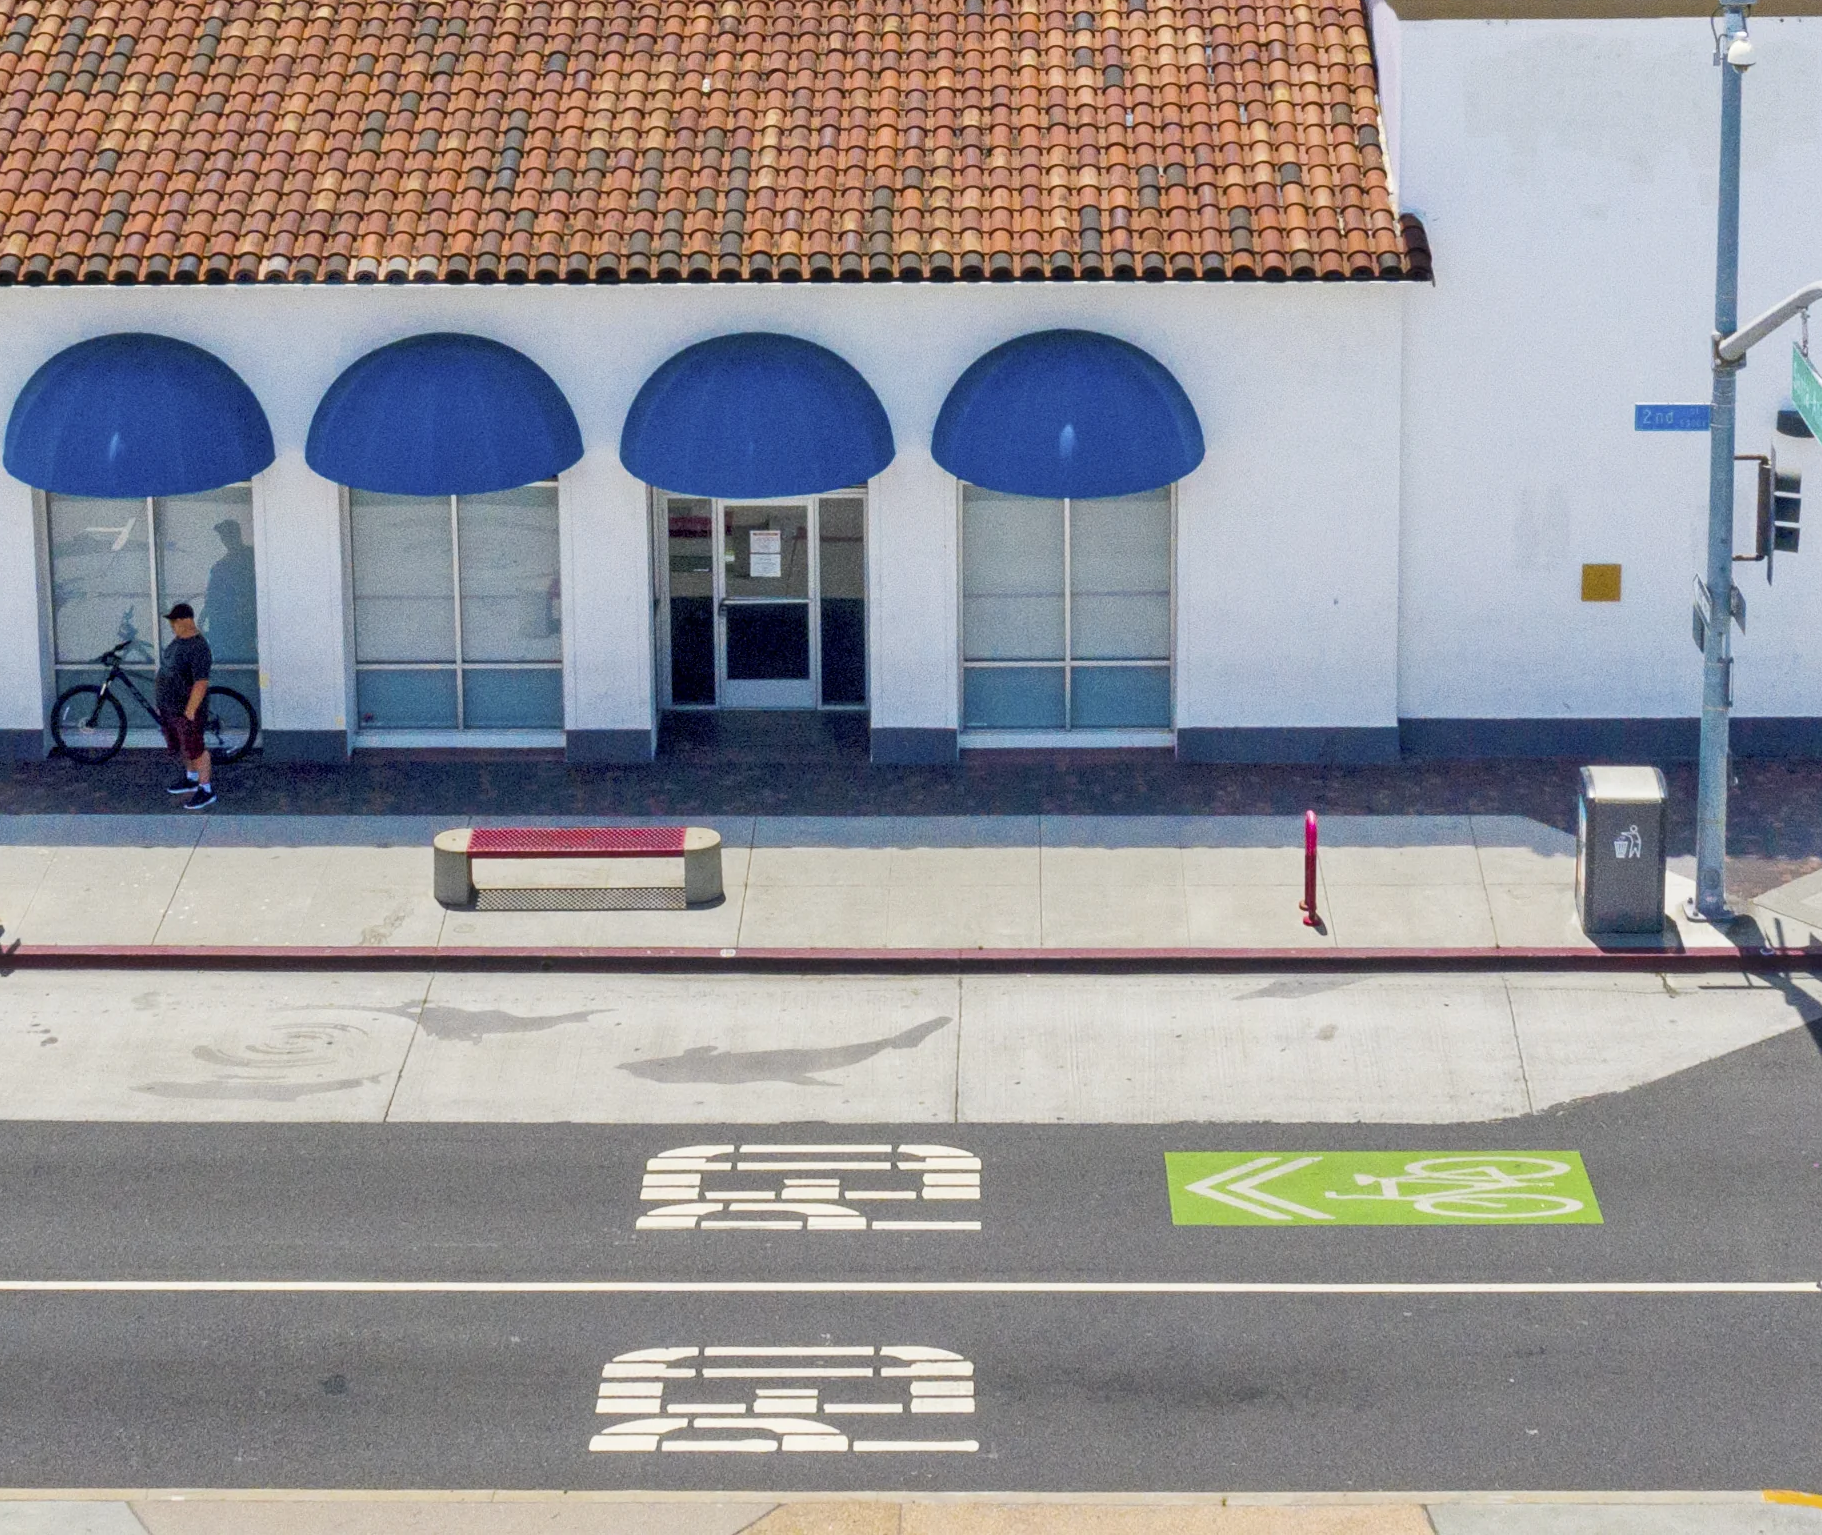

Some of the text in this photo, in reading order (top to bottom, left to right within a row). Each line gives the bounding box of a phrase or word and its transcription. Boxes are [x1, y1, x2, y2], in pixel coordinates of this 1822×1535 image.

[1642, 409, 1675, 425] 2nd
[635, 1143, 982, 1231] PED
[588, 1346, 980, 1452] PED
